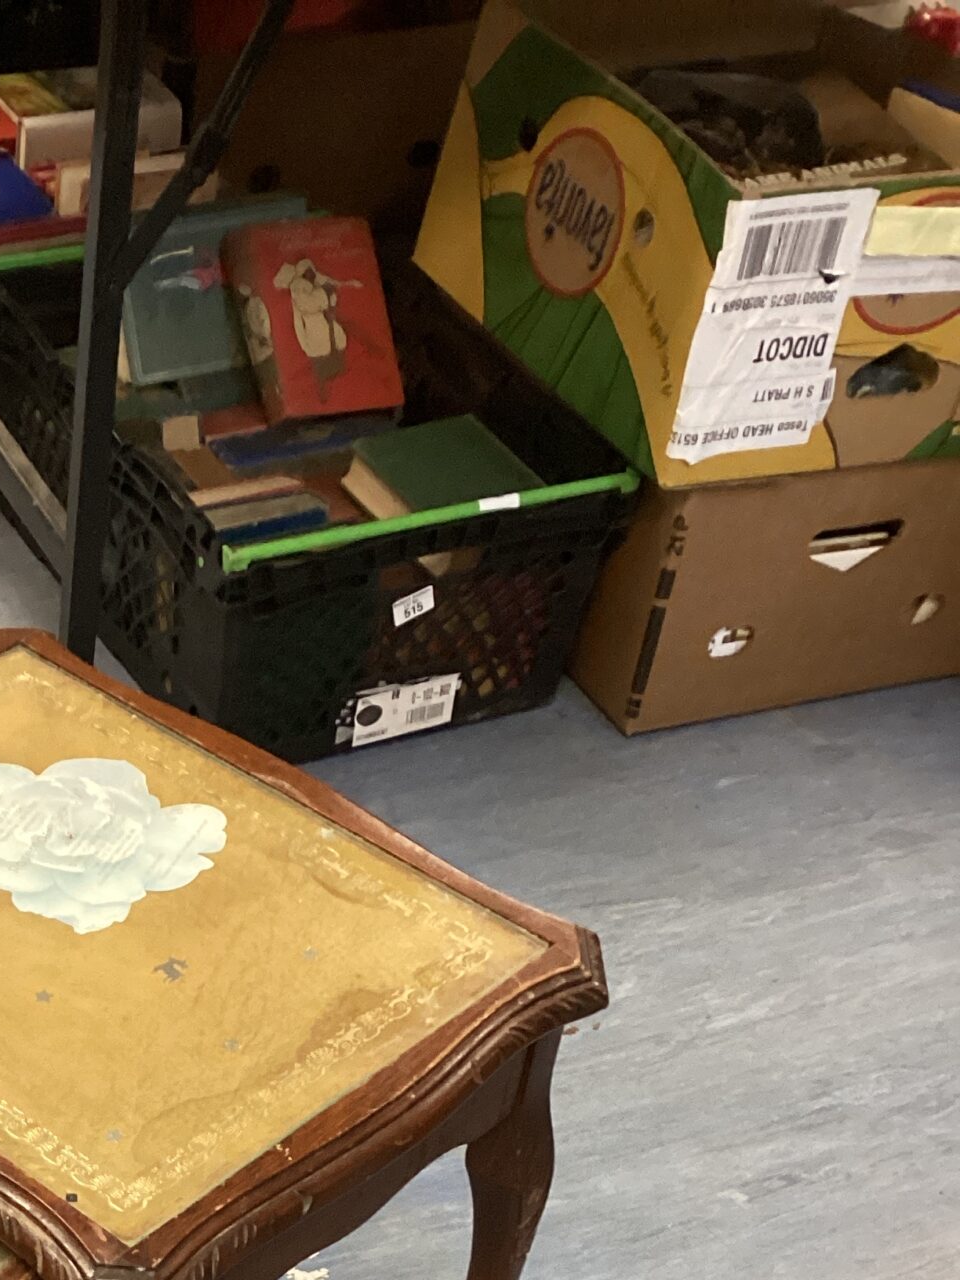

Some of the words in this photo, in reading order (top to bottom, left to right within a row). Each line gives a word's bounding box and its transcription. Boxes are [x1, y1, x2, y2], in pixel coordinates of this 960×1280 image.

[752, 333, 829, 364] DIDCOT
[752, 387, 791, 403] PRATT
[793, 386, 803, 399] H
[805, 385, 815, 398] S
[742, 424, 774, 439] HEAD
[777, 419, 808, 432] Tesco
[701, 427, 739, 444] OFFICE
[403, 601, 424, 619] 515
